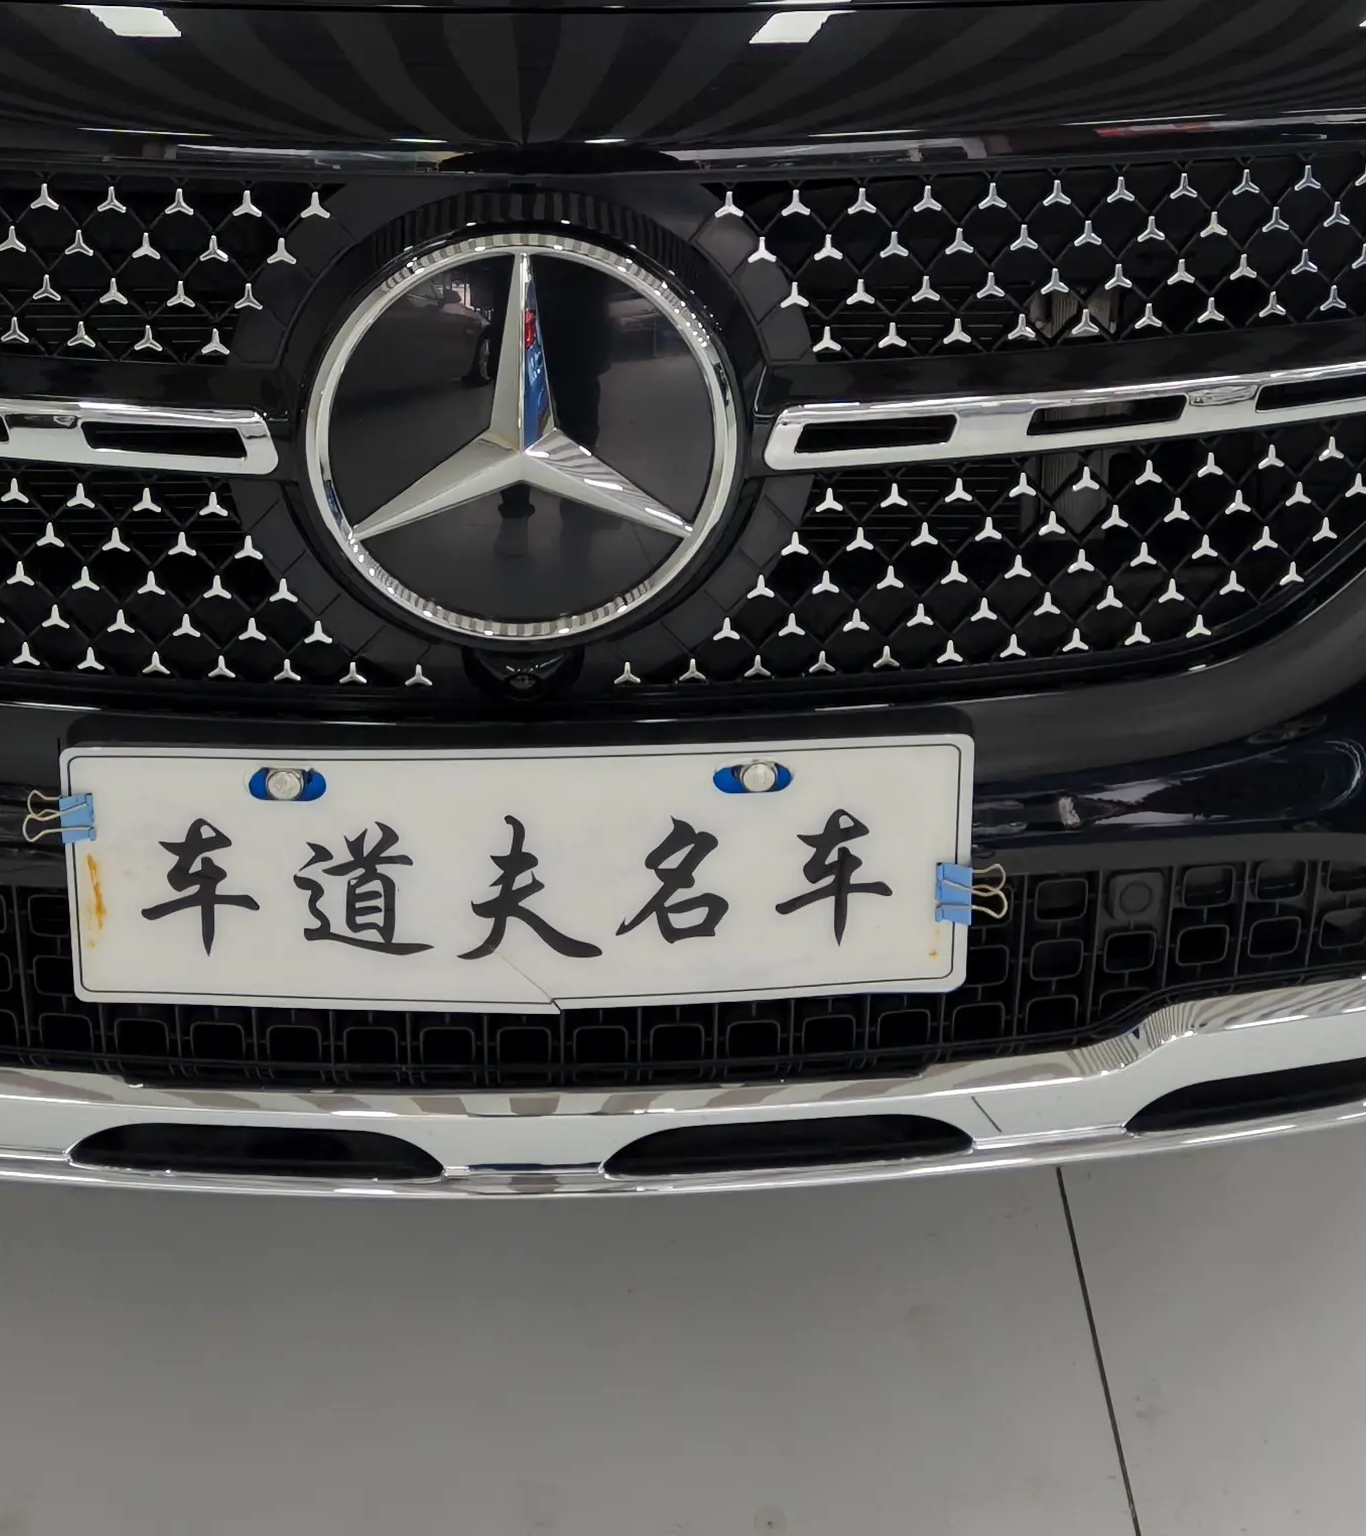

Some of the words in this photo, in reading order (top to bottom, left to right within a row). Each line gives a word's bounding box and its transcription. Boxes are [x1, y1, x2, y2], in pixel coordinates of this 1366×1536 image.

[141, 808, 893, 961] 车道夫名车
